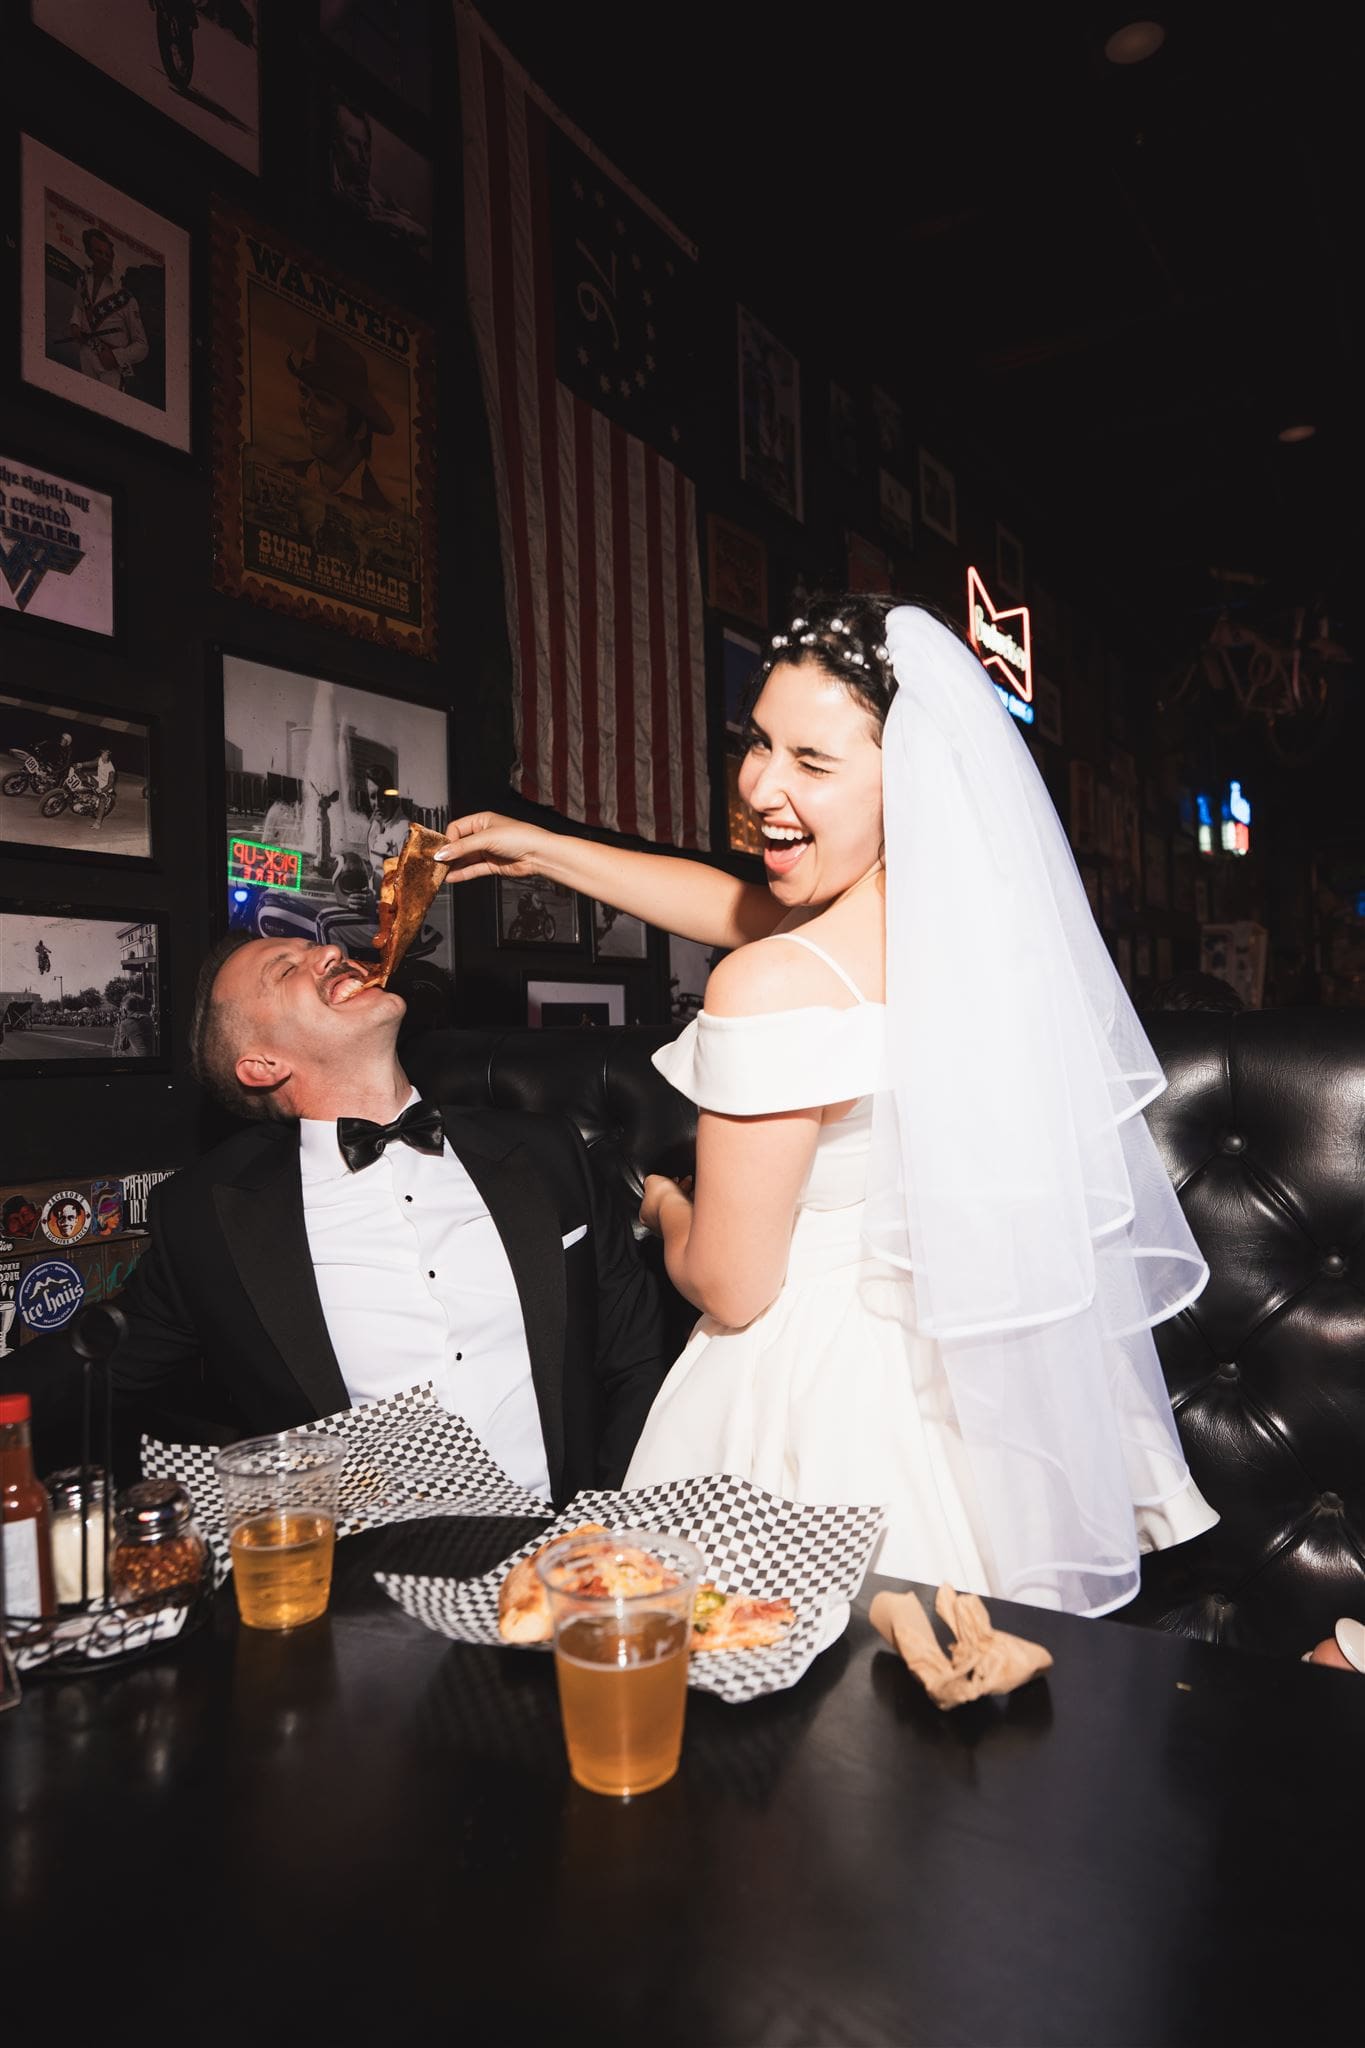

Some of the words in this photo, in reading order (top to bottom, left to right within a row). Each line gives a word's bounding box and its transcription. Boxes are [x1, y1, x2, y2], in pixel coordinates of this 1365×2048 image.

[247, 237, 410, 354] WANTED
[22, 472, 63, 503] eighth
[66, 488, 90, 513] day
[11, 496, 70, 527] created
[11, 514, 80, 549] HALEN
[258, 529, 312, 569] BURT
[316, 553, 409, 601] REYNOLDS
[68, 774, 80, 789] 50
[22, 1303, 44, 1324] ice
